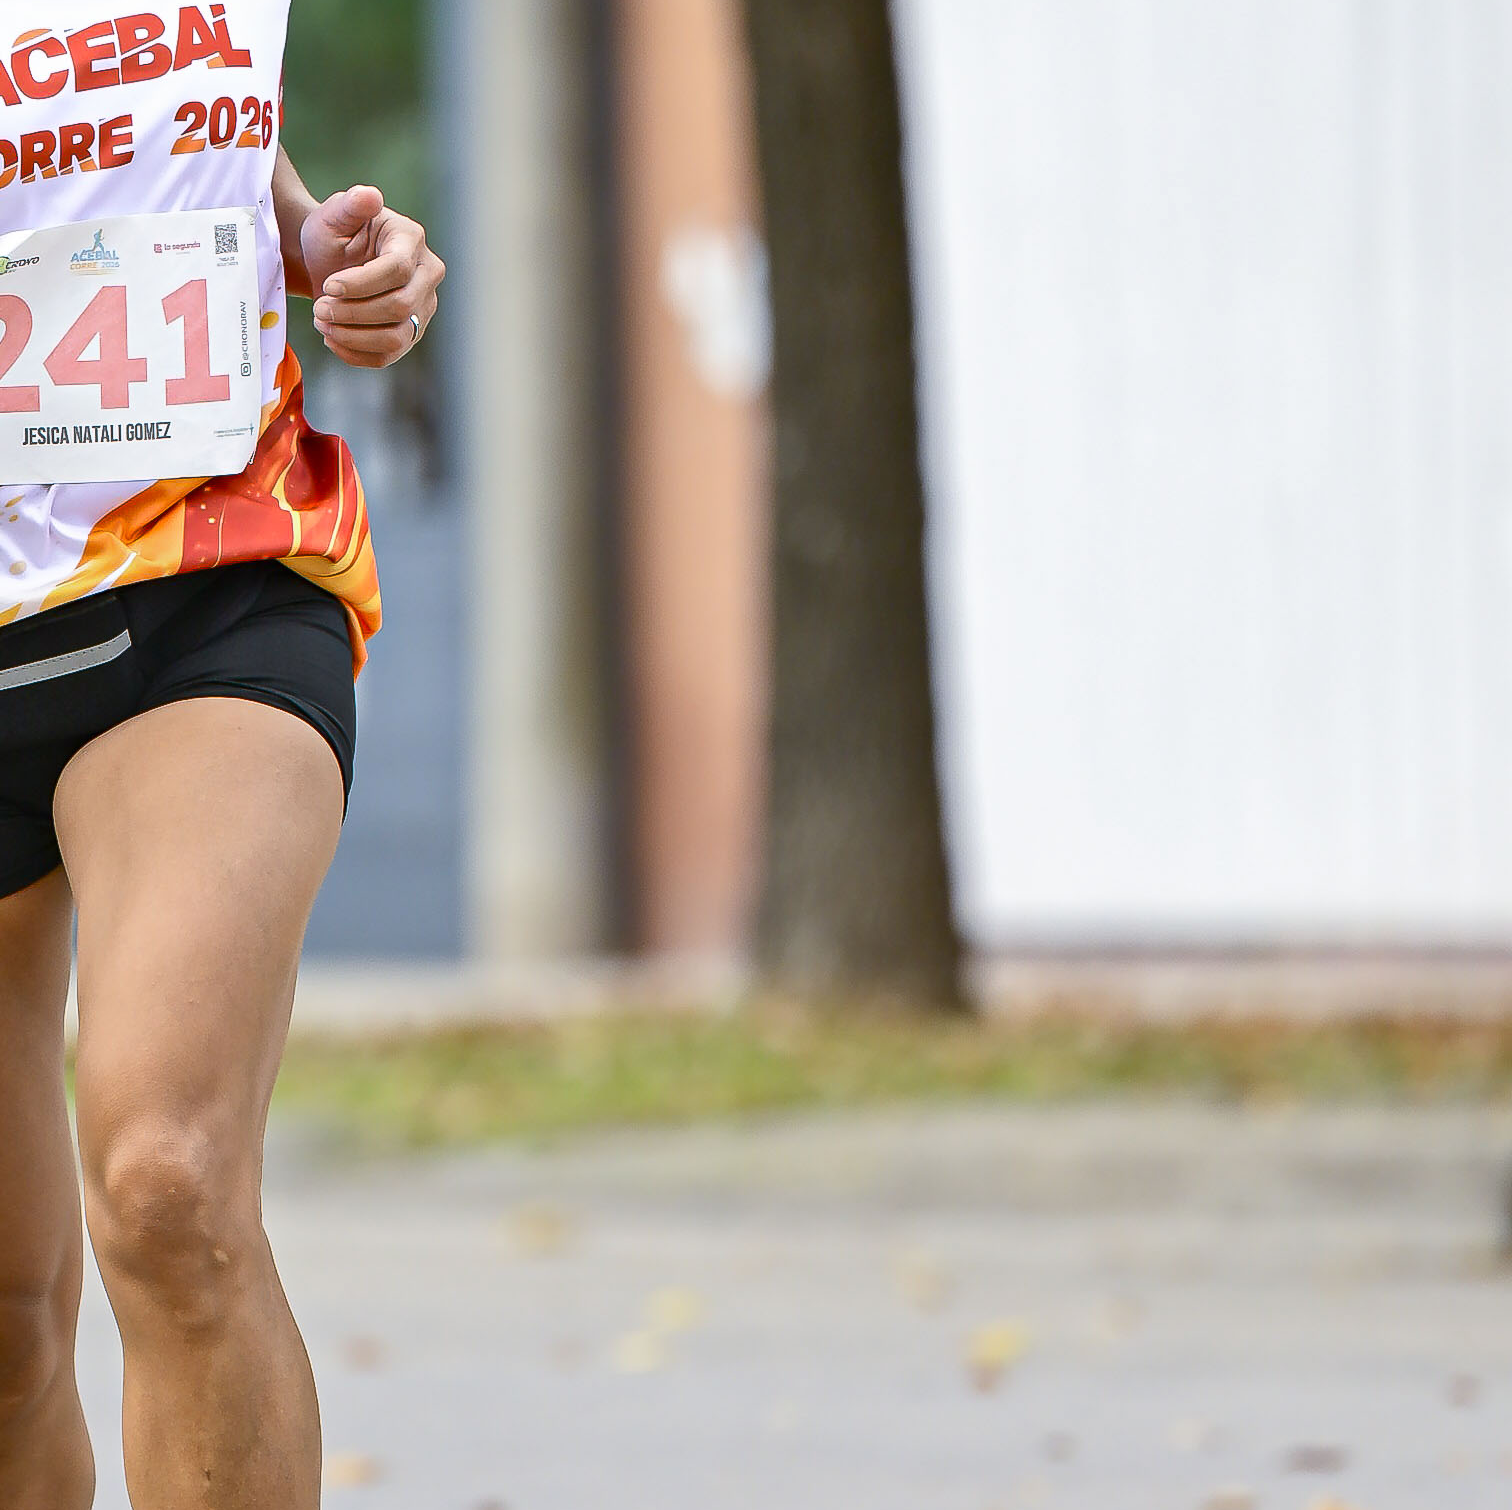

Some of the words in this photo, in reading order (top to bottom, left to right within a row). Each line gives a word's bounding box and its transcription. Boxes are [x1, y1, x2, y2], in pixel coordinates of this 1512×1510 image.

[170, 96, 272, 157] 2026
[70, 249, 120, 262] ACEBAL
[22, 426, 70, 446] JESICA
[73, 423, 122, 444] NATALI
[125, 421, 172, 441] GOMEZ
